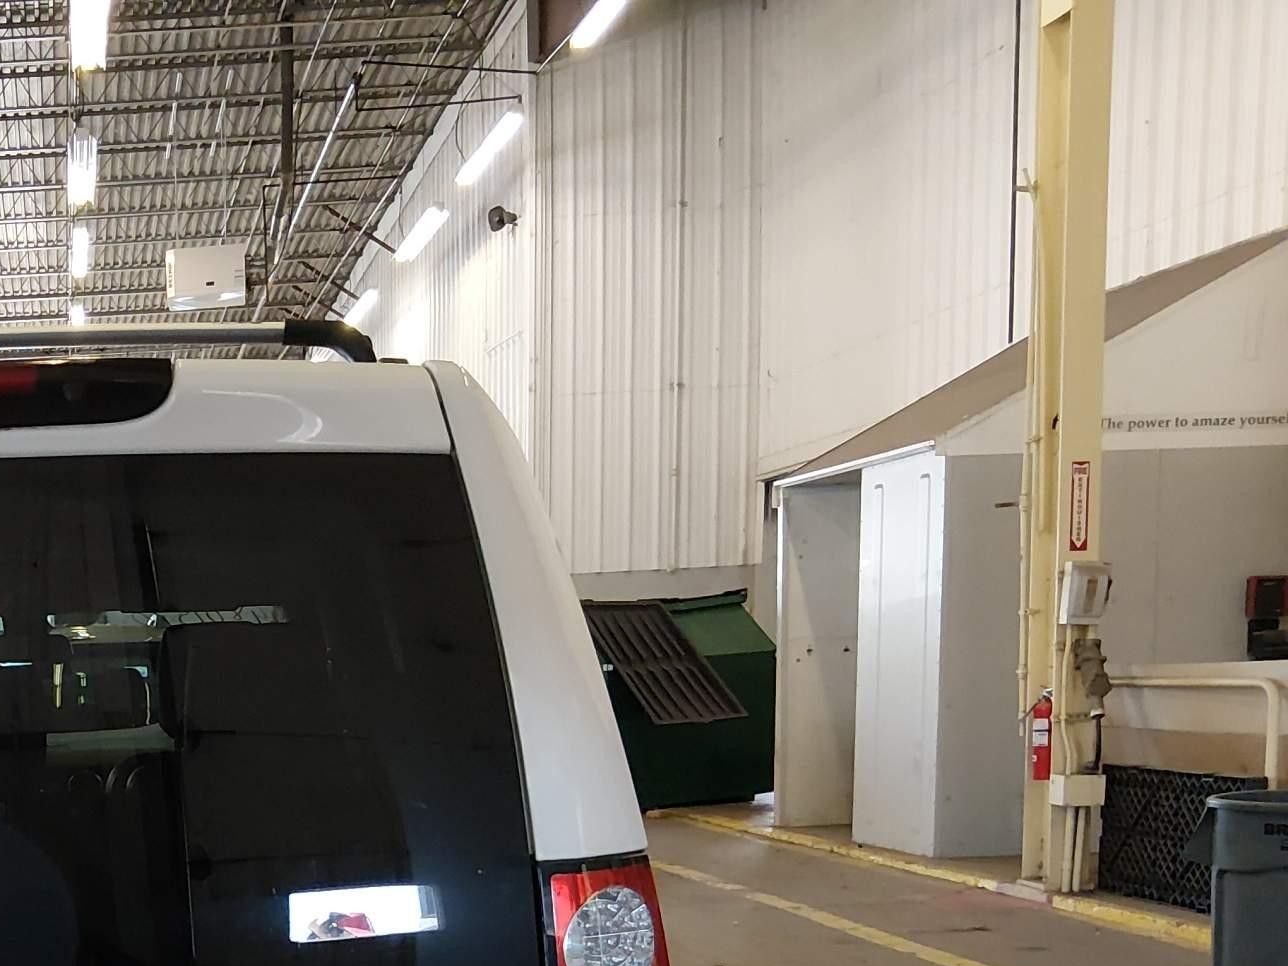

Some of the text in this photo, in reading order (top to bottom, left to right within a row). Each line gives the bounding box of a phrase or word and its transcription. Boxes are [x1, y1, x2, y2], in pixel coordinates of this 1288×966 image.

[1128, 417, 1172, 433] power
[1175, 416, 1188, 428] to
[1191, 414, 1236, 428] amaze
